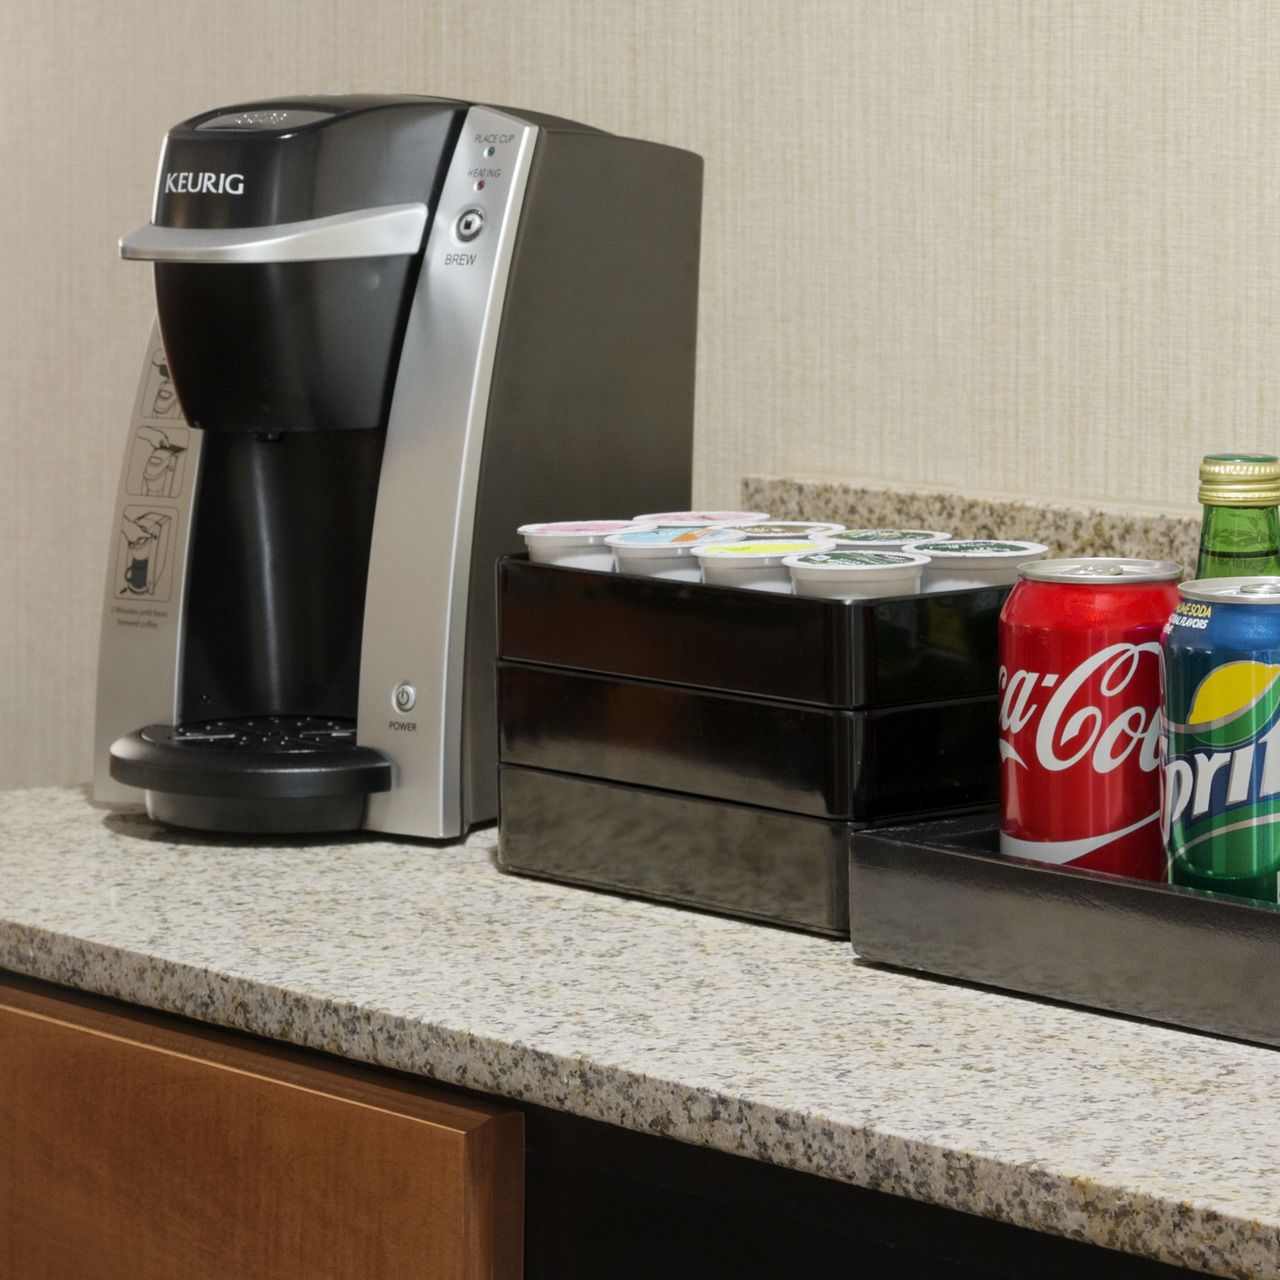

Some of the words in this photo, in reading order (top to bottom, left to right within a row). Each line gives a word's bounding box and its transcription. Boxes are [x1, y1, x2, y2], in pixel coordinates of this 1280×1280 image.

[467, 168, 501, 178] HEATING
[165, 172, 245, 195] KEURIG
[444, 254, 477, 266] BREW
[1191, 604, 1211, 618] SODA
[389, 720, 417, 732] POWER
